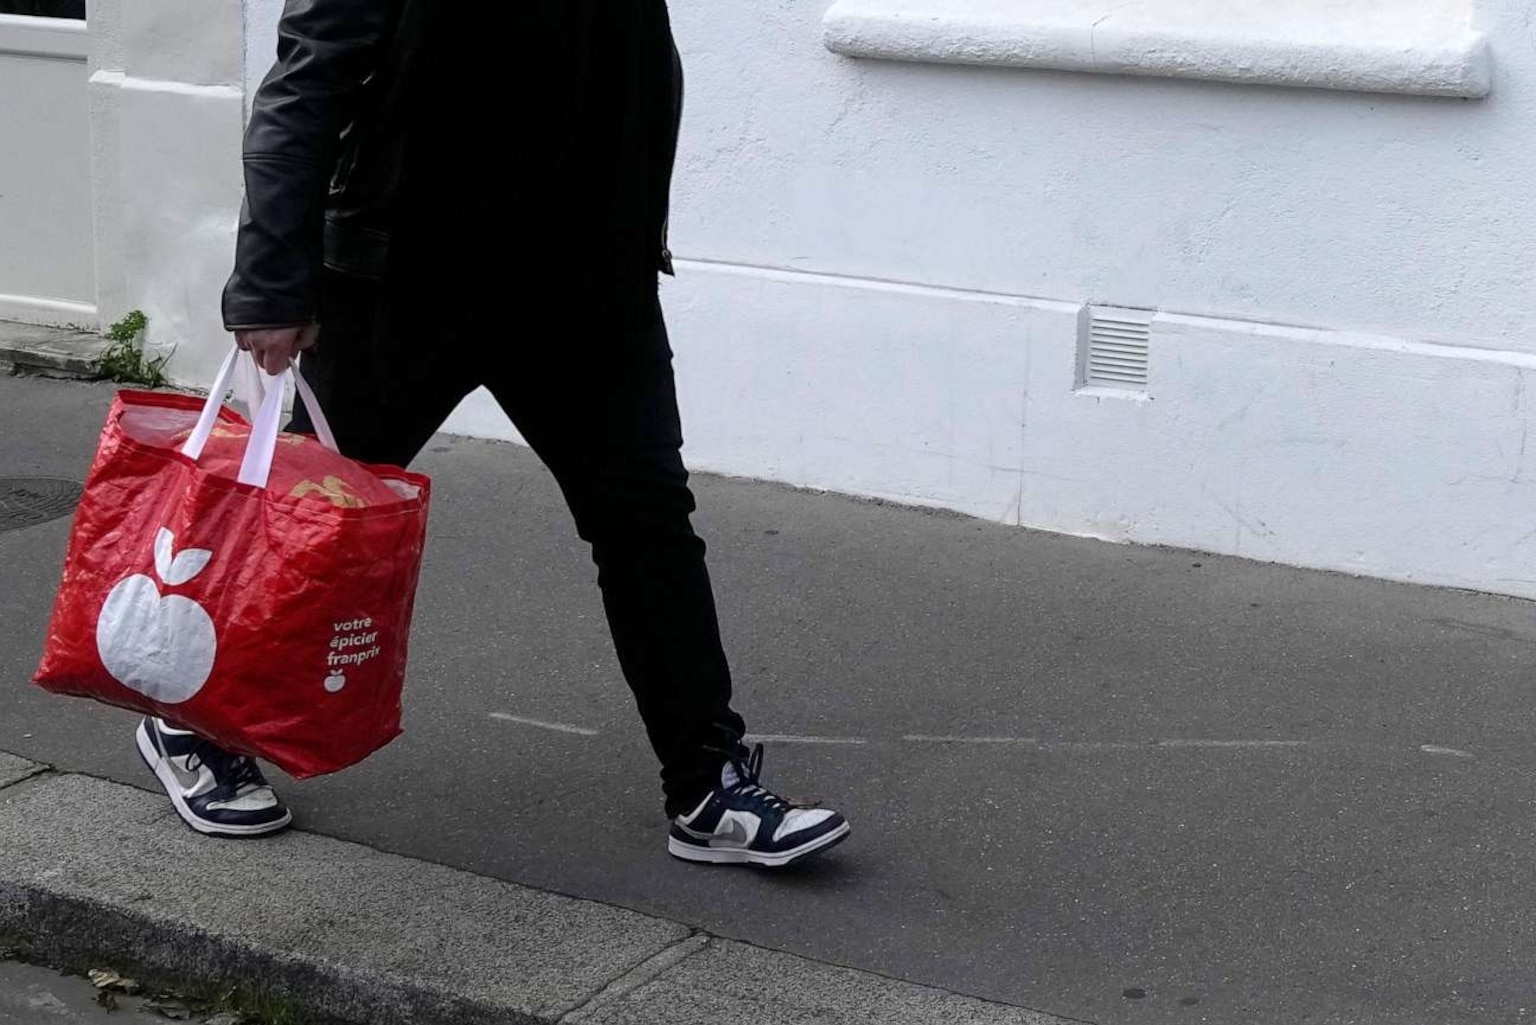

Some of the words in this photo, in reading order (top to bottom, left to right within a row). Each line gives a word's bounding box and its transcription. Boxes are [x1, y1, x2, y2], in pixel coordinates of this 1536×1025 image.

[333, 617, 372, 631] votre
[329, 631, 378, 650] épicier
[327, 646, 380, 665] franprix
